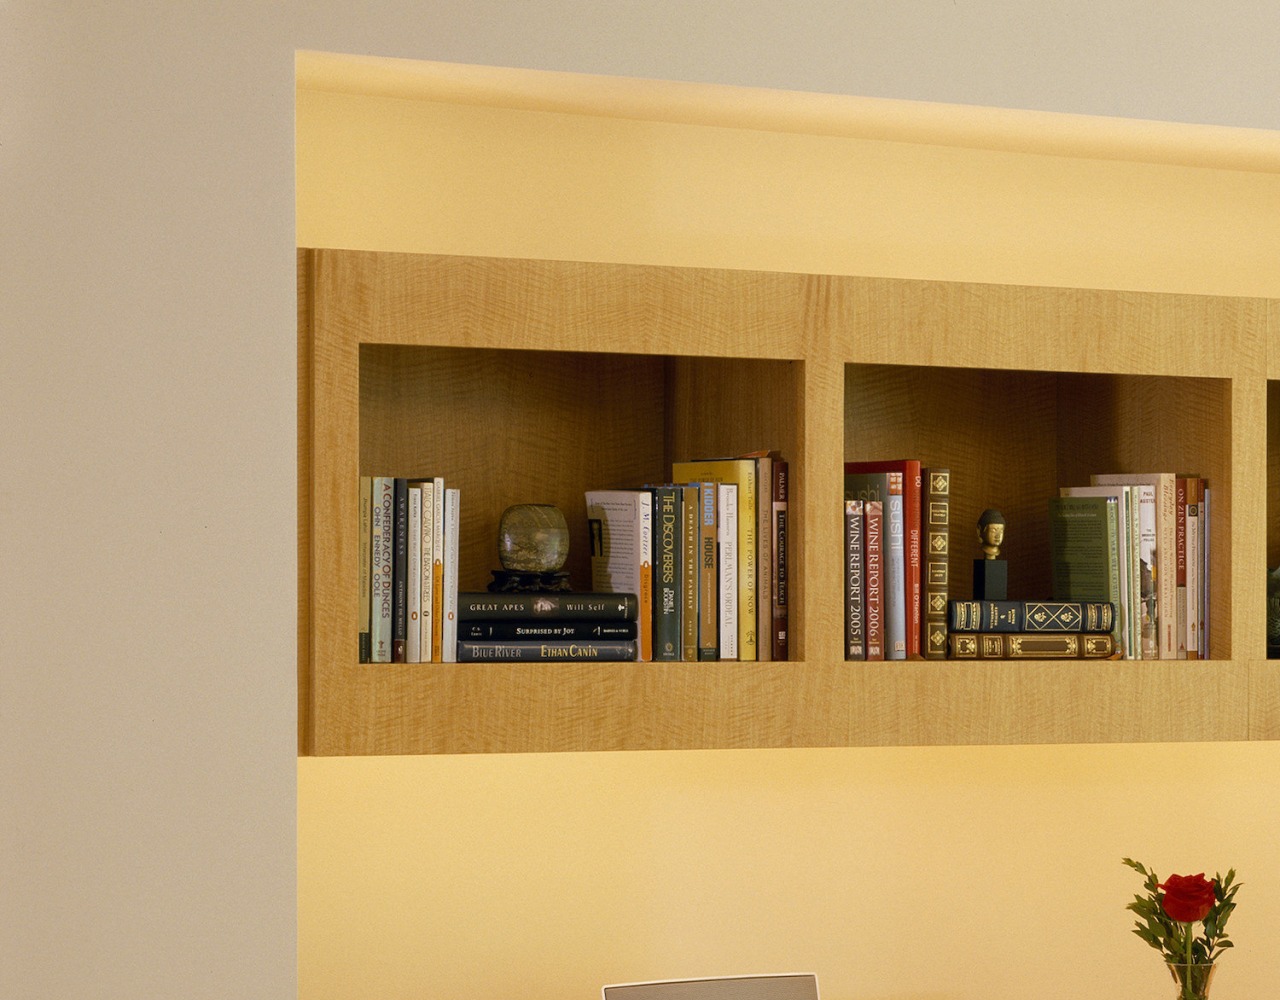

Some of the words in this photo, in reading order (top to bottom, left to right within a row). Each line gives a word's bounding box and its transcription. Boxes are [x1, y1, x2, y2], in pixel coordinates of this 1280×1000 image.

[382, 484, 392, 492] A
[915, 475, 921, 487] DO
[1178, 488, 1185, 504] ON
[423, 488, 432, 510] ITALO
[663, 492, 676, 513] THE
[704, 488, 714, 526] KIDDER
[382, 493, 392, 564] CONFEDERACY
[423, 511, 432, 544] CALVINO
[850, 516, 860, 551] WINE
[869, 517, 879, 552] WINE
[890, 500, 903, 551] sushi
[642, 526, 650, 556] Coetzee
[663, 514, 676, 583] DISCOVERERS
[687, 545, 694, 555] IN
[704, 537, 714, 569] HOUSE
[911, 530, 919, 568] DIFFERENT
[382, 565, 392, 579] OF
[747, 581, 754, 592] OF
[779, 568, 786, 578] TO
[850, 553, 860, 603] REPORT
[869, 554, 879, 604] REPORT
[382, 581, 391, 619] DUNCES
[469, 603, 498, 611] GREAT
[502, 603, 525, 611] APES
[566, 603, 584, 611] Will
[588, 603, 605, 611] Self
[516, 627, 553, 635] SURPRISED
[554, 627, 561, 635] BY
[562, 627, 575, 636] JOY
[850, 605, 860, 635] 2005
[869, 606, 879, 637] 2006
[472, 646, 493, 658] BLUE
[494, 646, 522, 658] RIVER
[540, 645, 569, 657] ETHAN
[569, 645, 598, 657] CANIN
